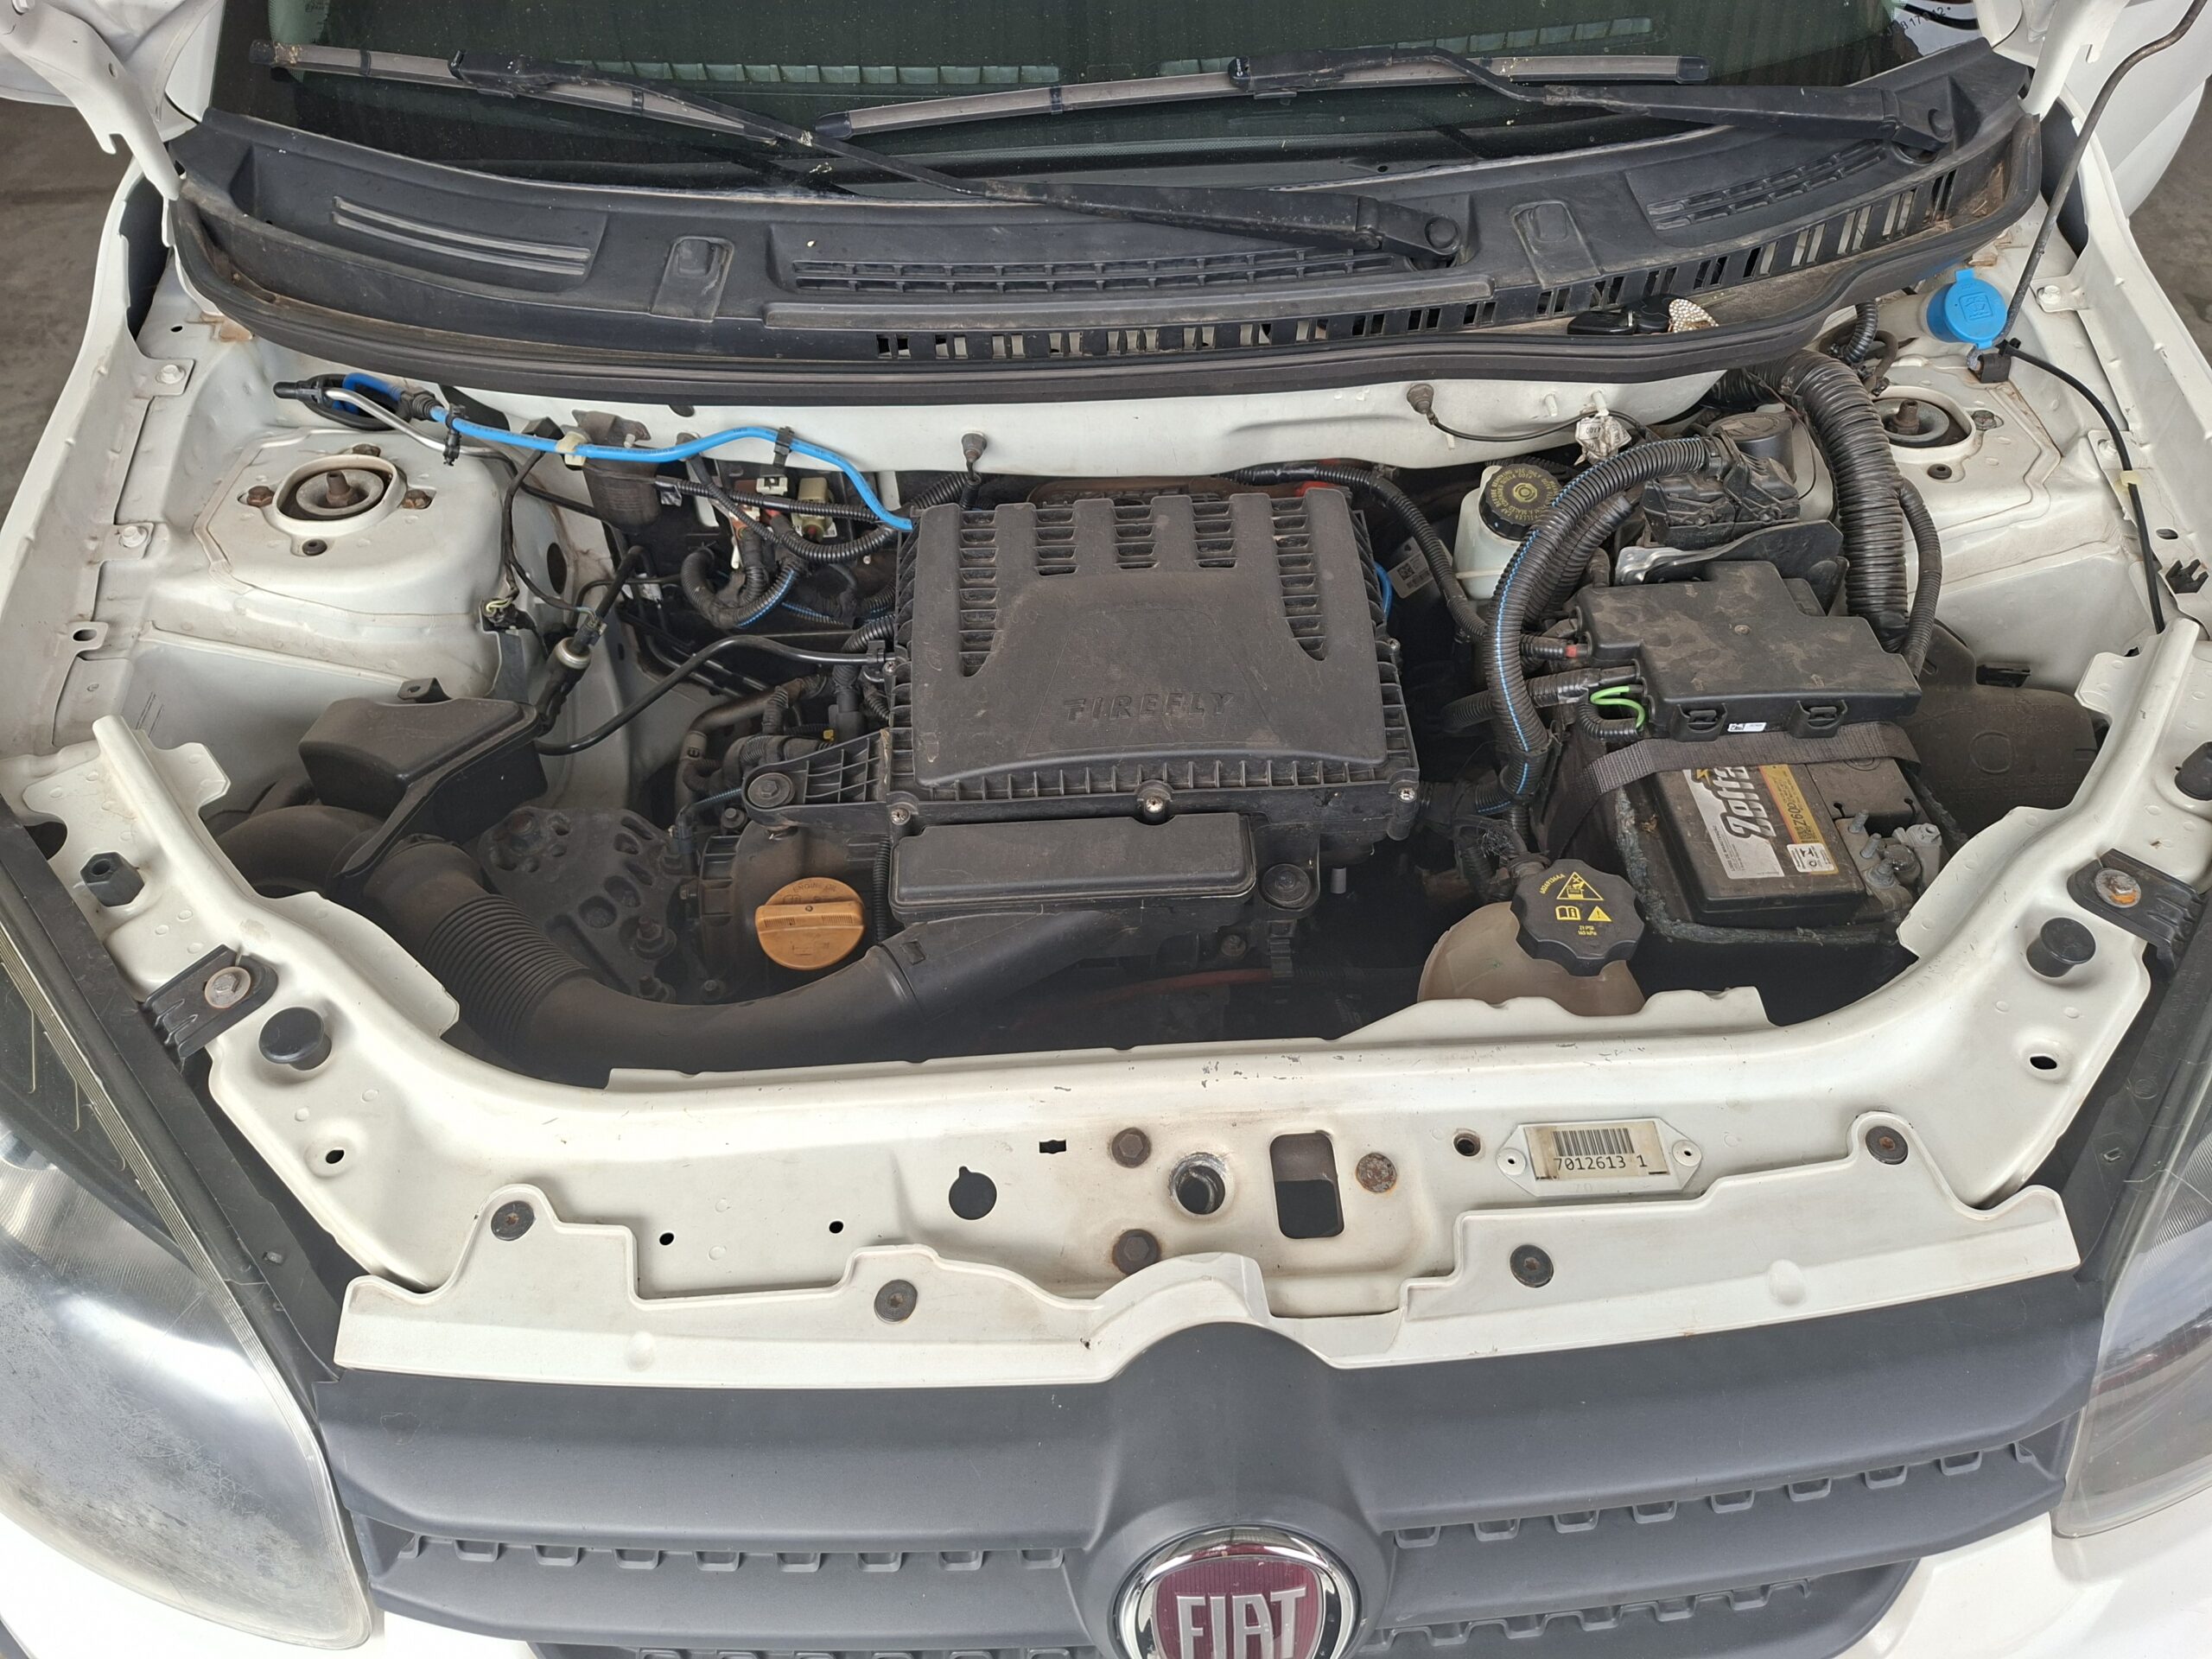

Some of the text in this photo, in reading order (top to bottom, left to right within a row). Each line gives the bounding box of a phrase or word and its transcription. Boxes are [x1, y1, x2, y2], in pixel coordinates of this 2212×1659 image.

[1063, 691, 1235, 722] FIREFLY
[1553, 1154, 1648, 1173] 7012613 1
[1175, 1586, 1306, 1659] FIAT
